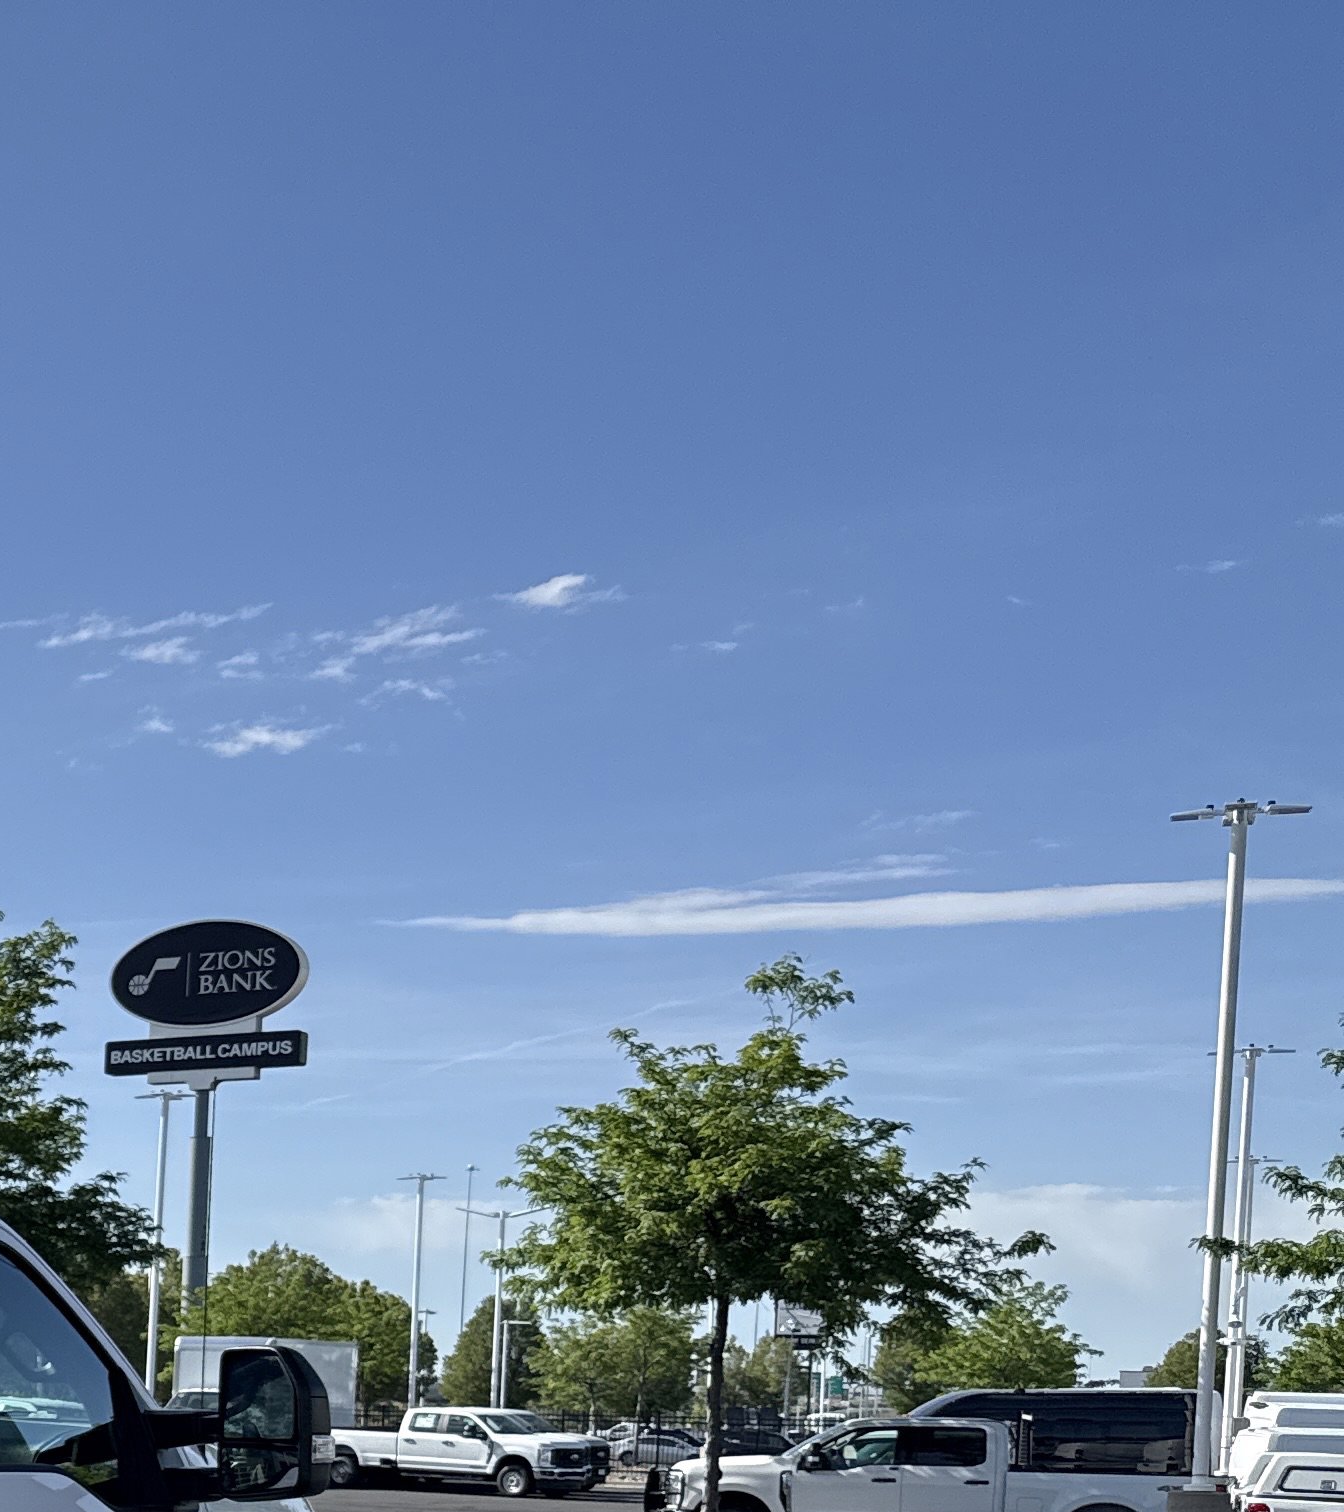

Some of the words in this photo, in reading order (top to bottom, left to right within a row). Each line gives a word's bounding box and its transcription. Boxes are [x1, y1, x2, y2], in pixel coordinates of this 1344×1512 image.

[198, 947, 276, 972] ZIONS
[198, 970, 276, 995] BANK
[110, 1046, 215, 1065] BASKETBALL
[217, 1040, 293, 1057] CAMPUS
